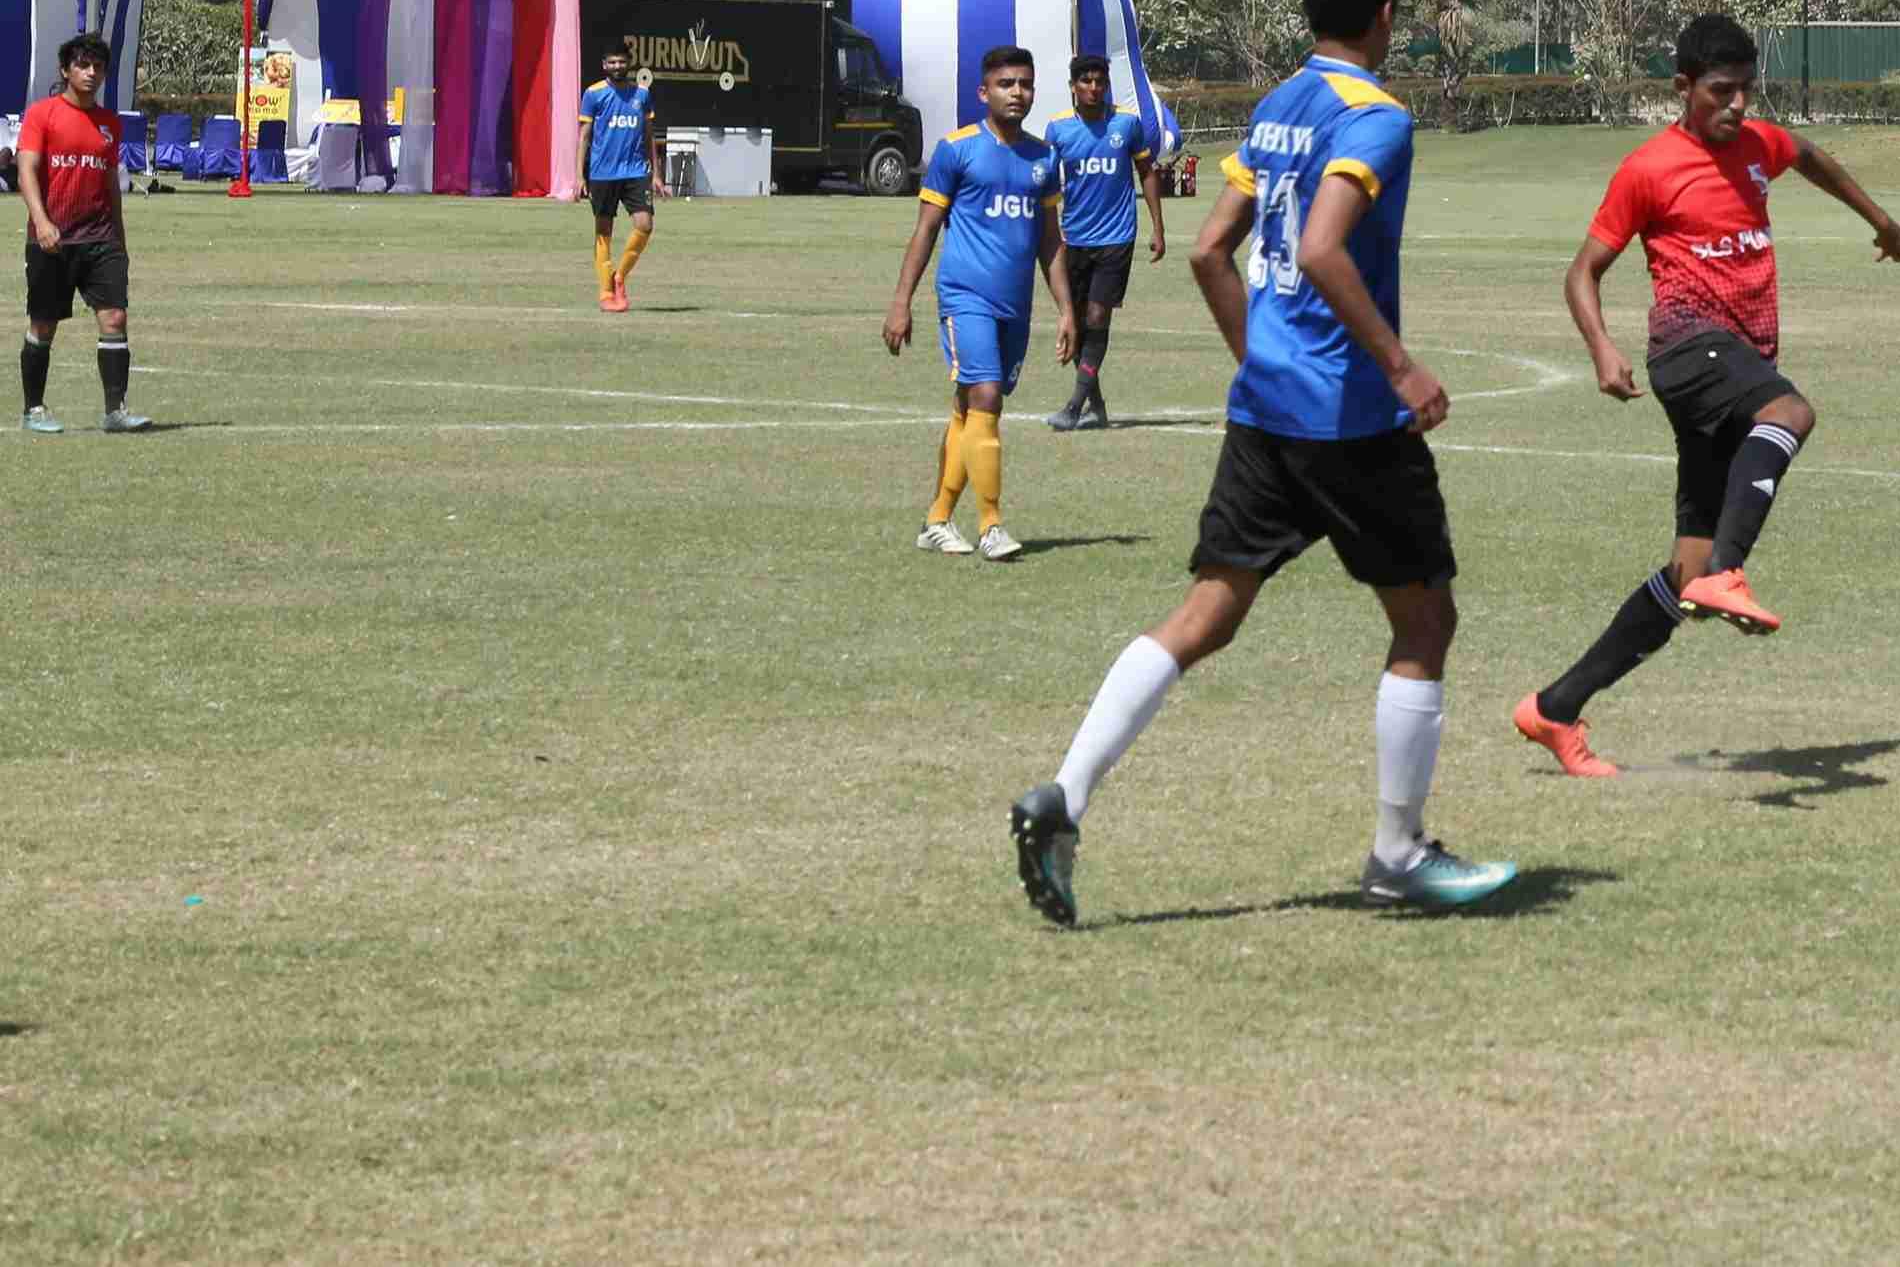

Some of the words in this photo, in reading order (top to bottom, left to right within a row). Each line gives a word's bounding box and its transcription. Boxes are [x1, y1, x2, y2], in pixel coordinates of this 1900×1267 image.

[624, 35, 739, 71] BURNOUT
[608, 115, 638, 128] JGU
[51, 154, 77, 168] SLS
[1076, 157, 1117, 175] JGU
[985, 194, 1036, 219] JGU
